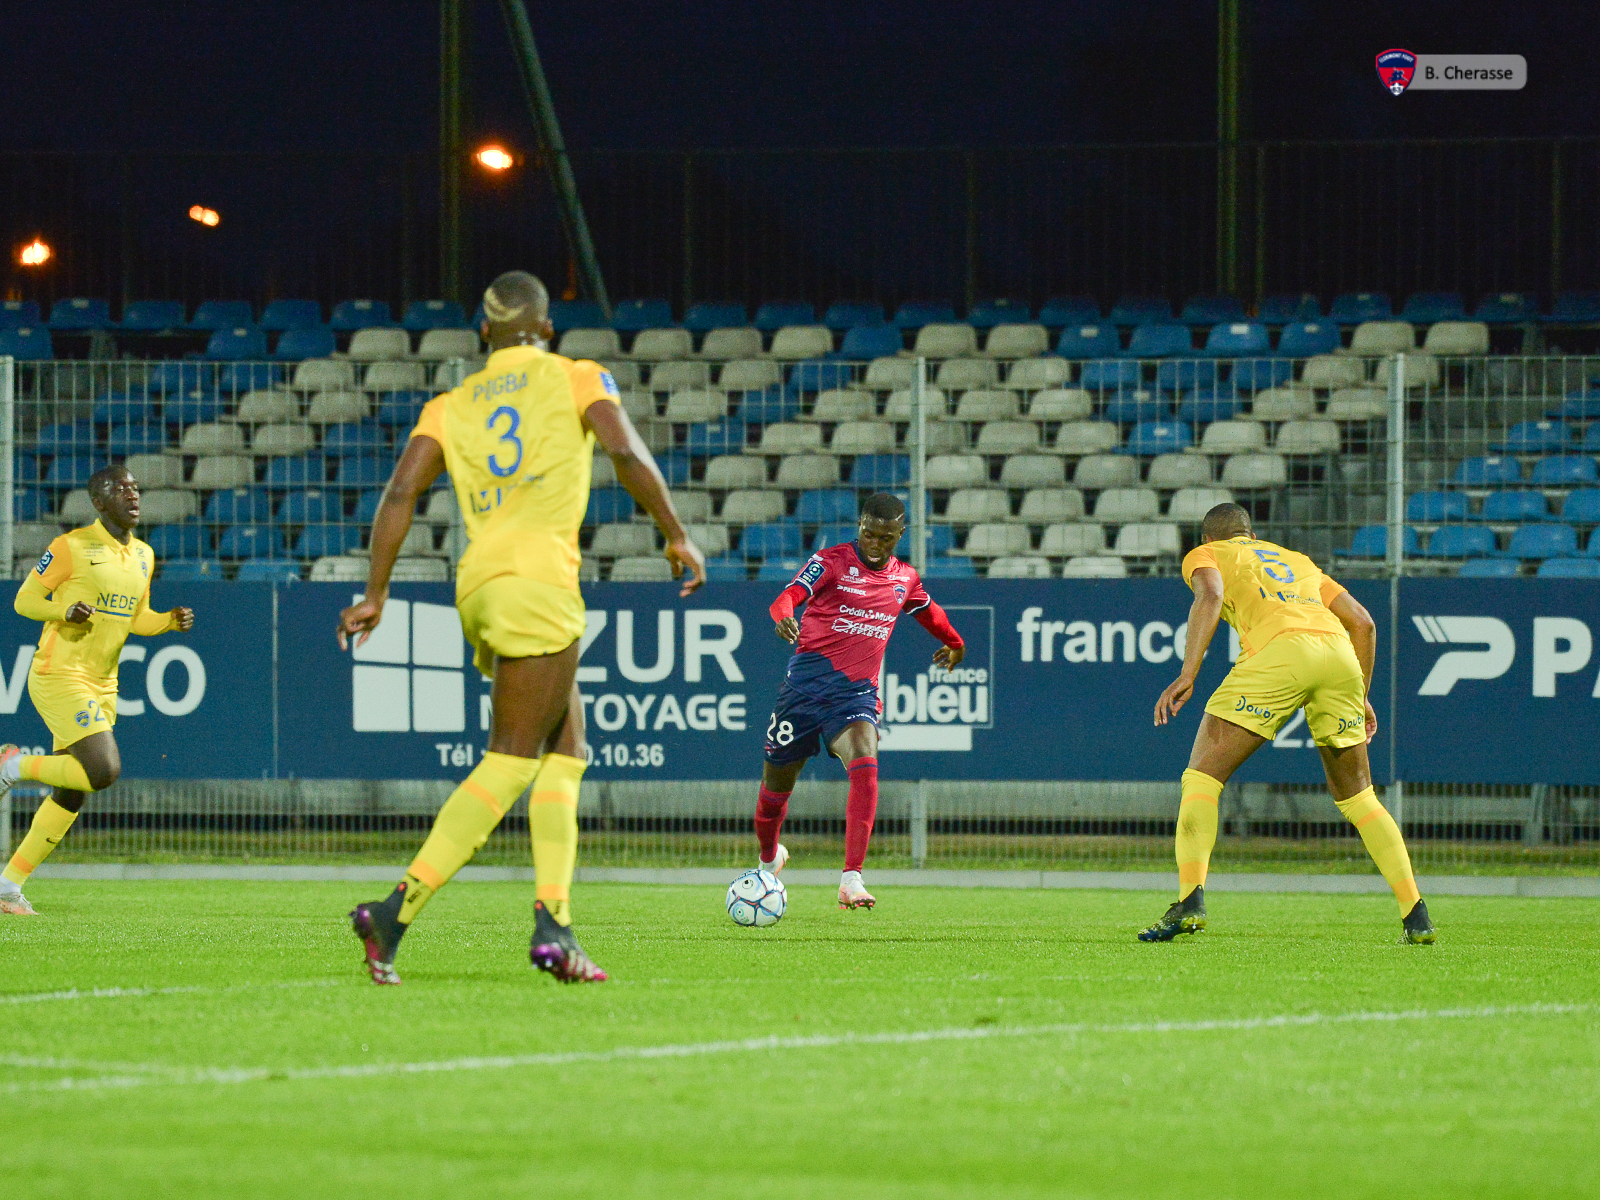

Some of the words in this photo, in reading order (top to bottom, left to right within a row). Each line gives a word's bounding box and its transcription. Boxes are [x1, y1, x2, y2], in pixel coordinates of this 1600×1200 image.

[486, 406, 523, 477] 3
[1251, 548, 1295, 583] 5
[842, 585, 867, 596] PATRICK
[928, 664, 988, 683] france
[1532, 617, 1600, 698] P
[885, 672, 989, 723] bleu
[766, 712, 794, 746] 28
[435, 743, 473, 766] Tél
[585, 743, 665, 767] 0.10.36
